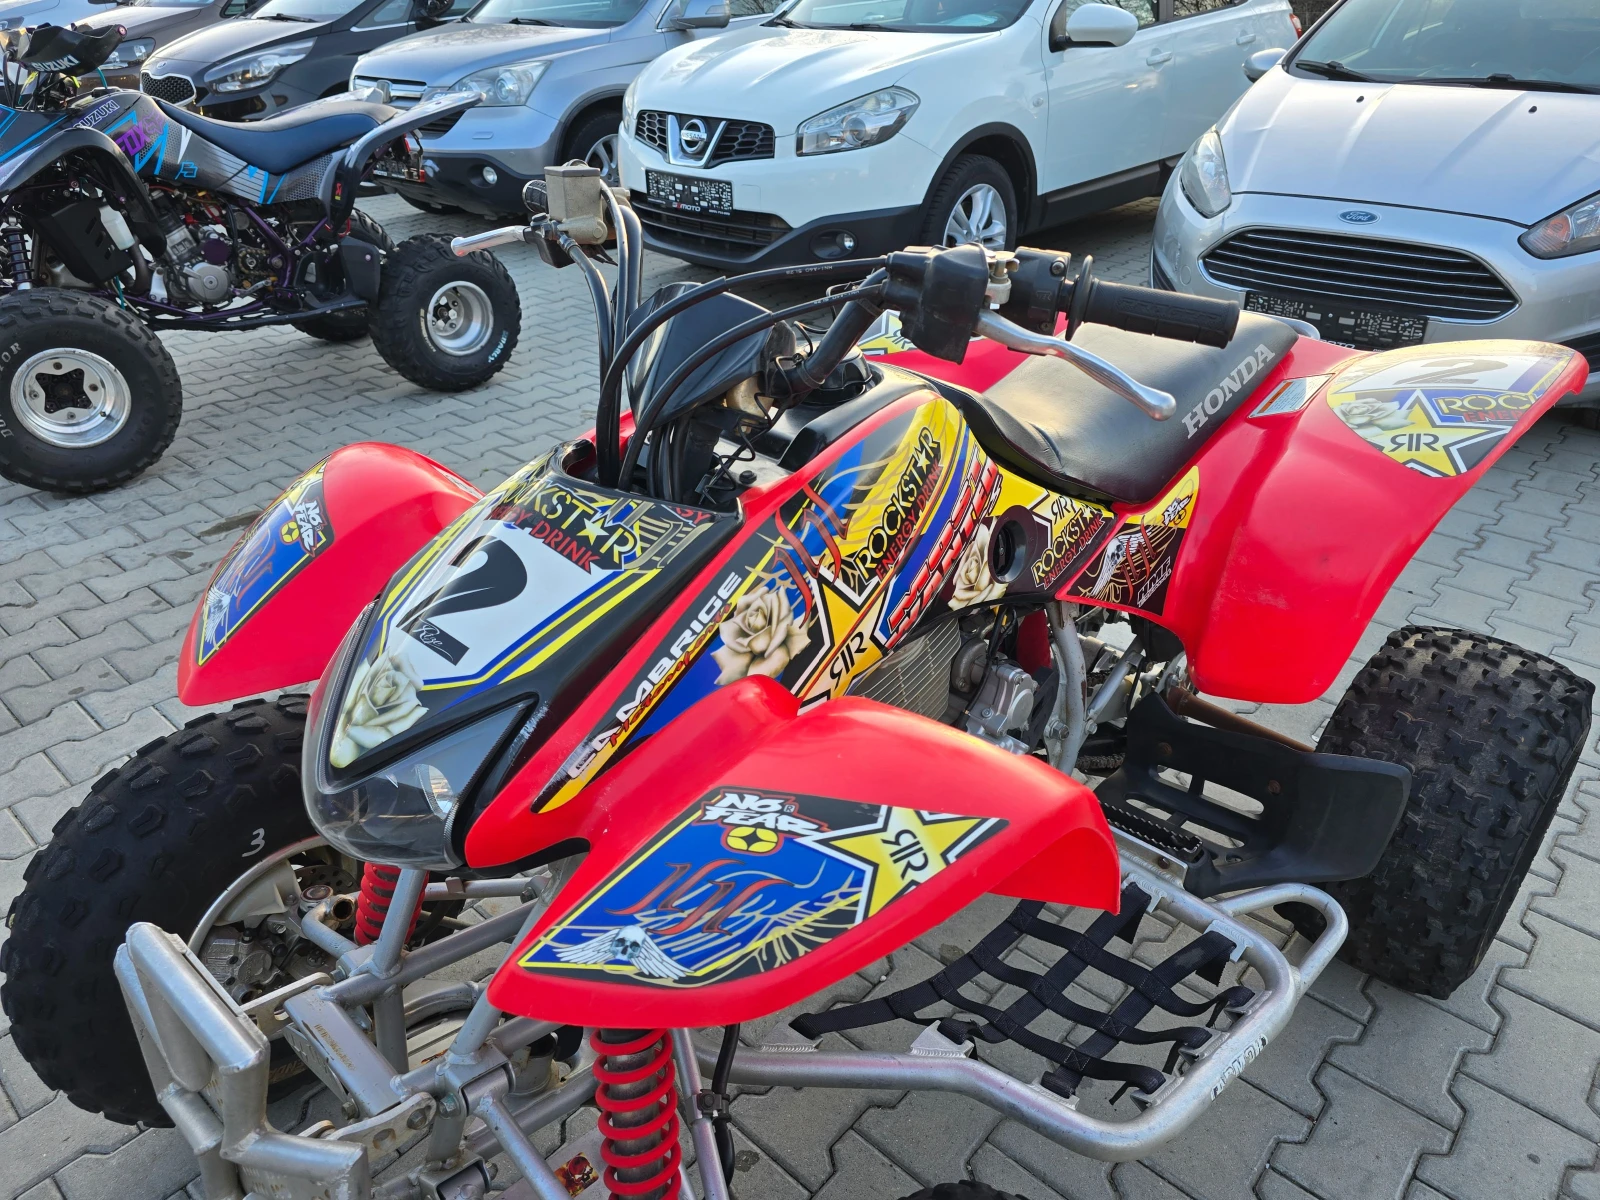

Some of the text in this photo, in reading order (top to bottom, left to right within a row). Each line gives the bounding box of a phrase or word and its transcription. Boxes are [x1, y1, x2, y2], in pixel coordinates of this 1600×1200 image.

[32, 54, 80, 73] SUZUKI
[73, 100, 120, 128] SUZUKI
[1393, 358, 1509, 386] 2
[1182, 344, 1275, 439] HONDA
[295, 502, 314, 551] FEAR
[305, 500, 323, 526] NO
[876, 460, 943, 582] ENERGY DRINK
[529, 520, 600, 574] DRINK
[1043, 515, 1104, 587] ENERGY DRINK
[395, 535, 528, 666] 2
[714, 792, 785, 812] NO
[701, 805, 822, 835] FEAR
[242, 828, 265, 857] 3
